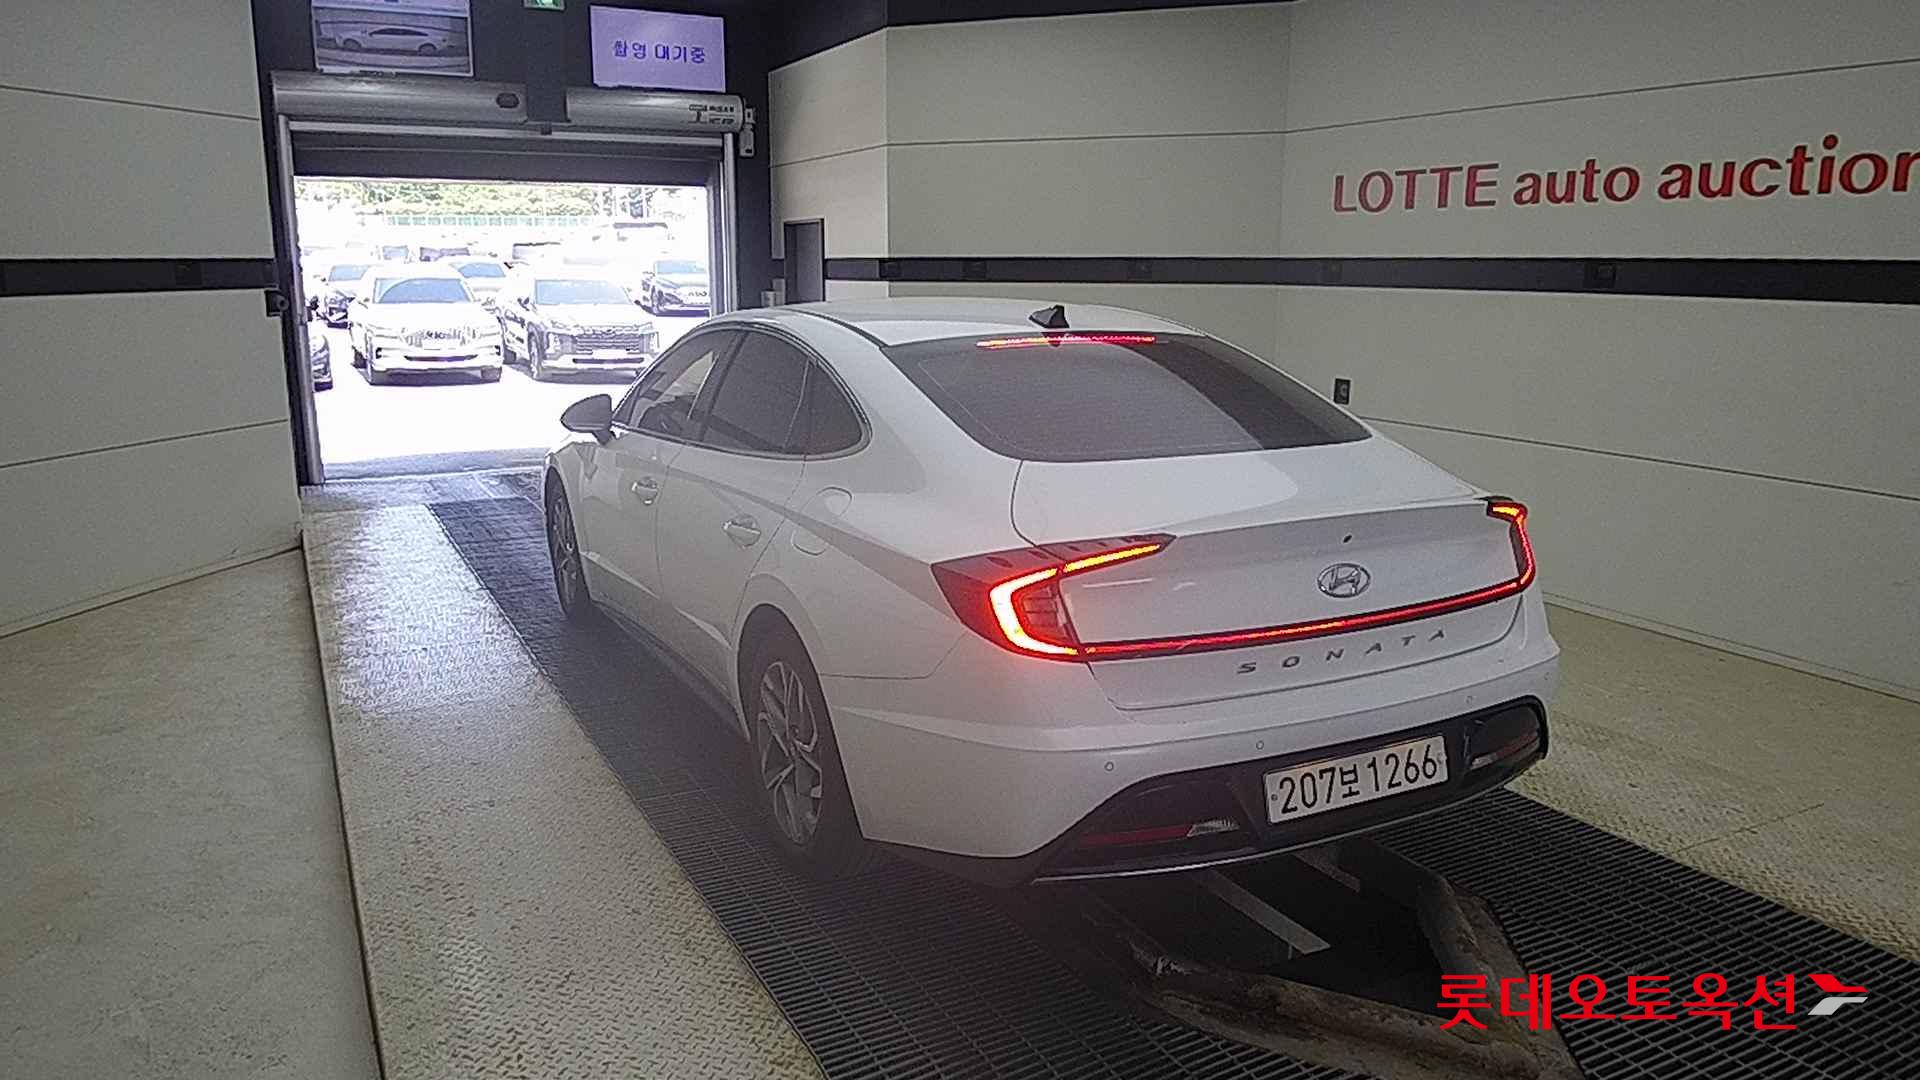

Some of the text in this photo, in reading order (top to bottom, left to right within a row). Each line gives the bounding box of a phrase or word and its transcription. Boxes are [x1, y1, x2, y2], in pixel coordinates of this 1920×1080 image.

[654, 43, 706, 64] 대기중
[1333, 162, 1500, 214] LOTTE
[1512, 158, 1641, 206] auto
[1236, 629, 1446, 675] SONATA
